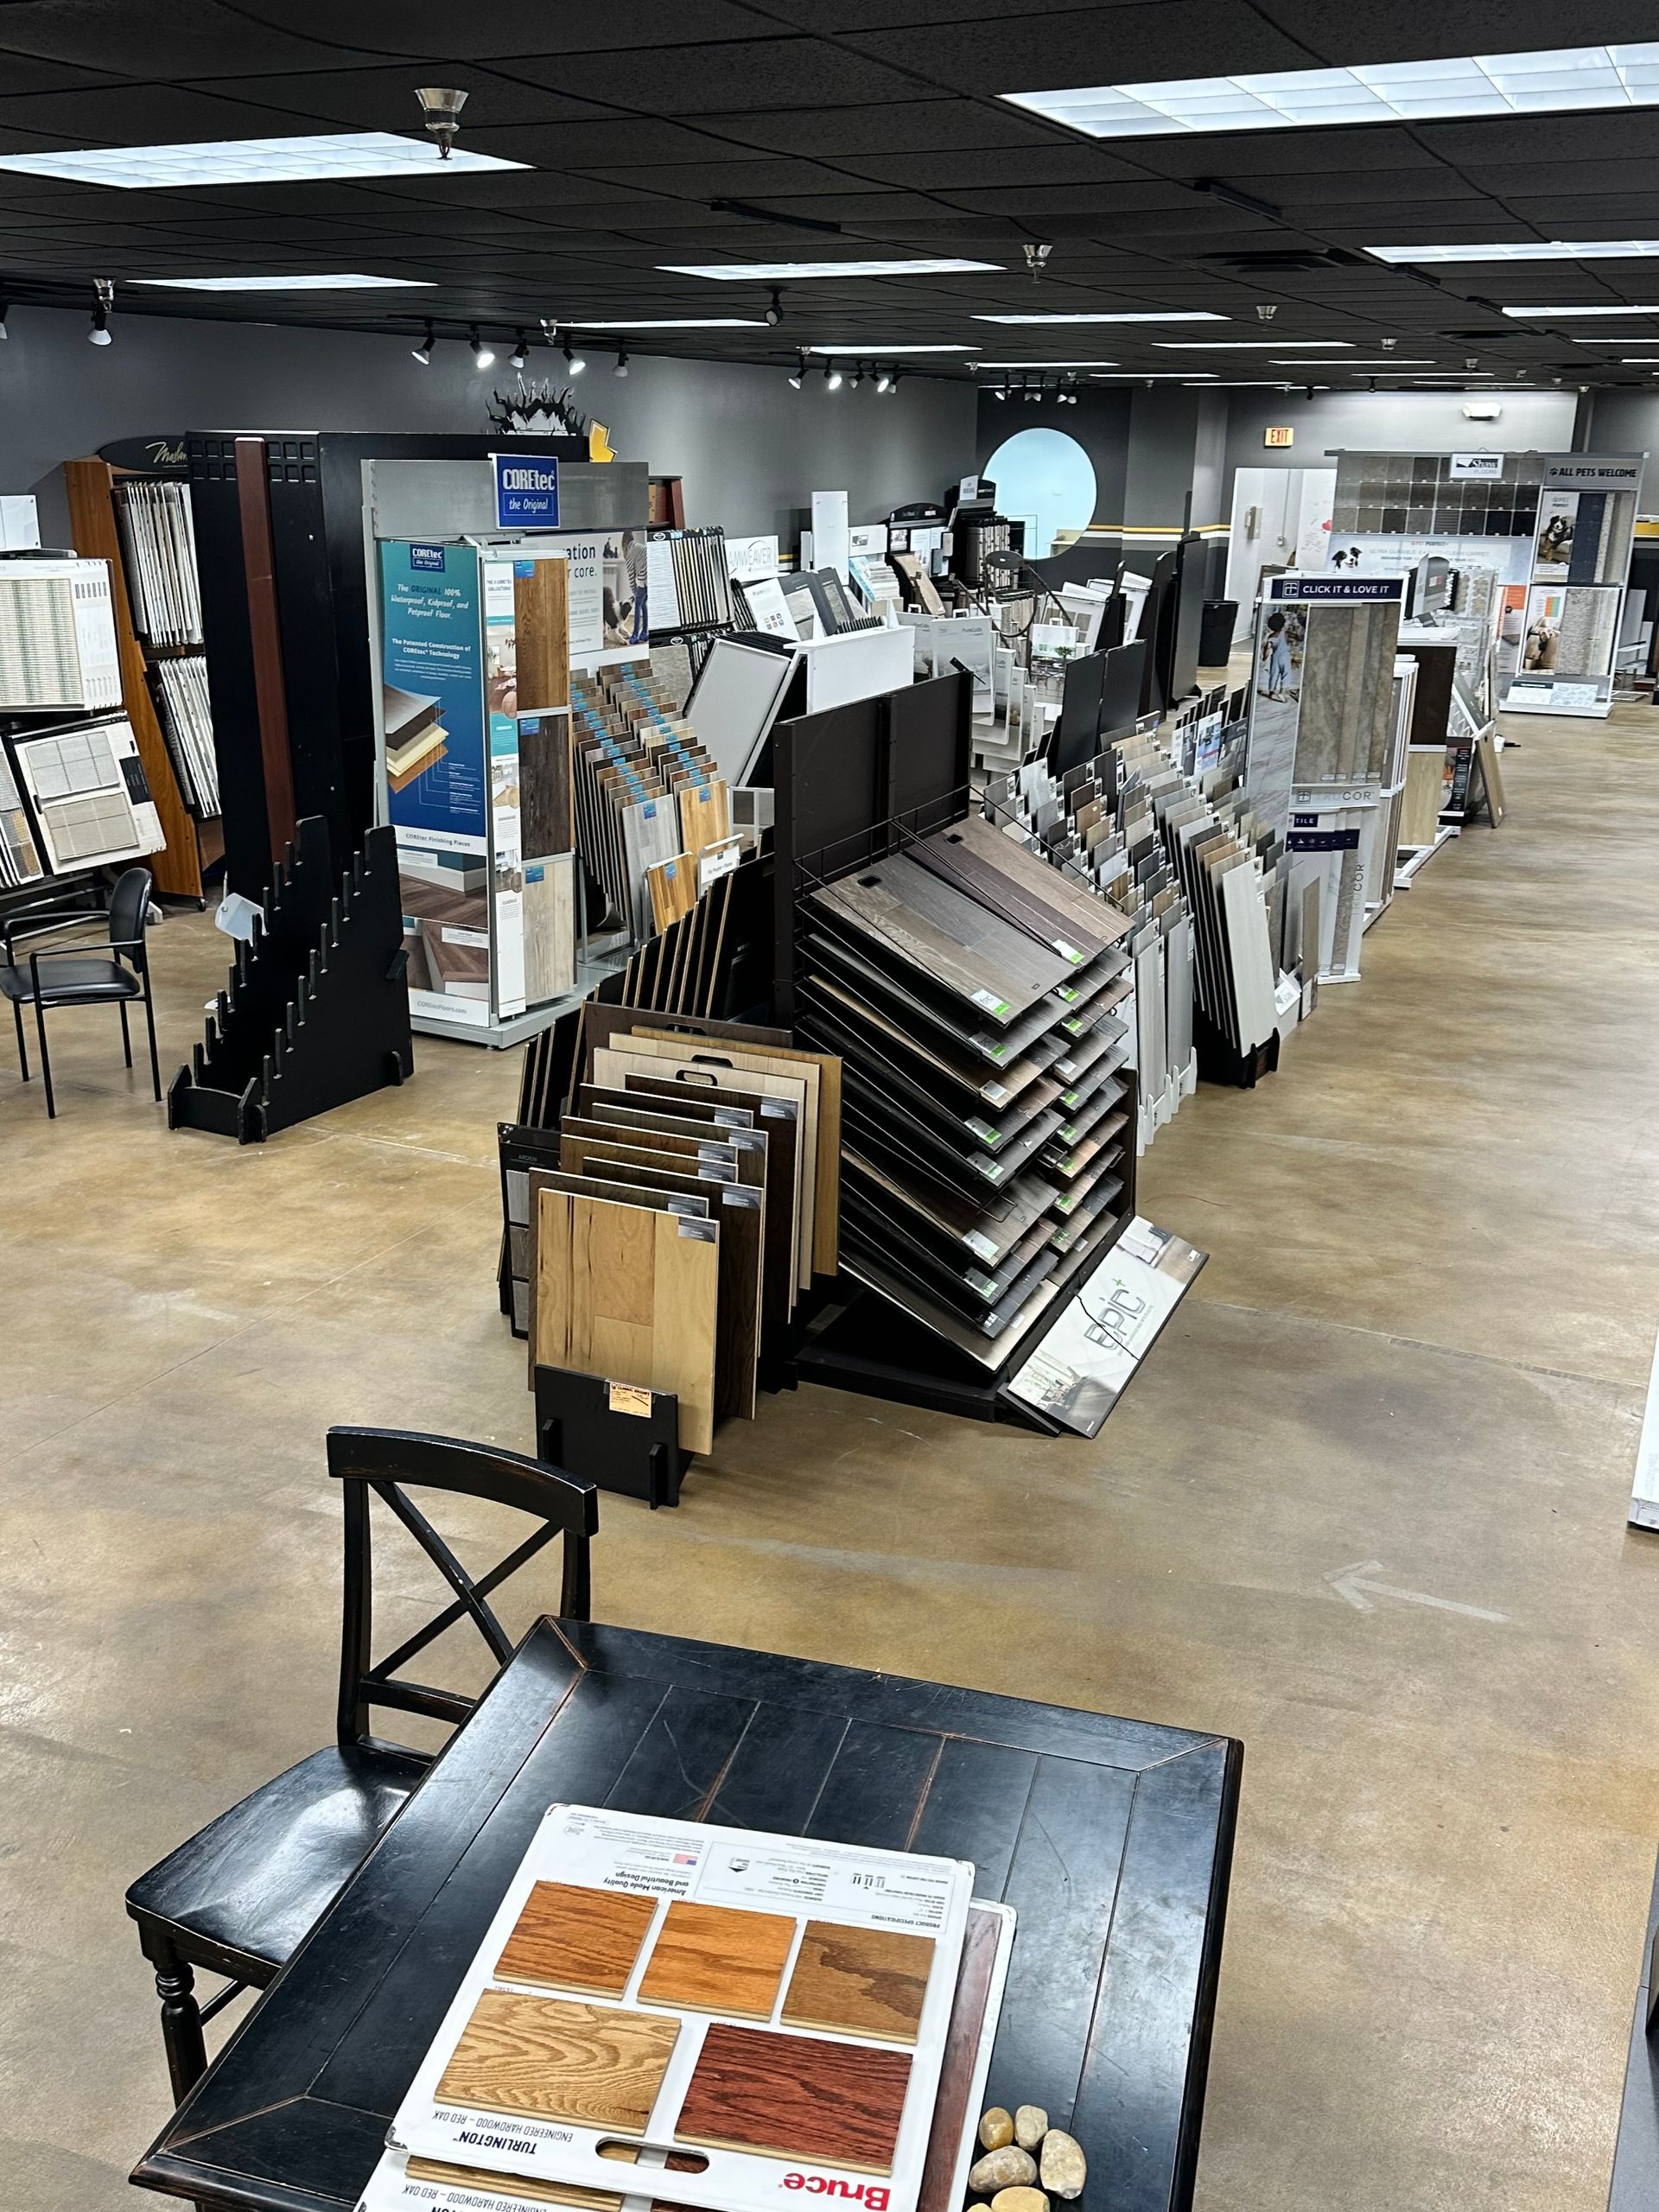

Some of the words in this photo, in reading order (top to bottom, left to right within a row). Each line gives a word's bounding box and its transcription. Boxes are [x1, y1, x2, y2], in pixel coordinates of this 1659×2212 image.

[1271, 429, 1288, 443] EXIT
[1472, 459, 1497, 468] Shaw
[1559, 467, 1573, 476] ALL
[1576, 467, 1596, 476] PETS
[1598, 468, 1637, 477] WELCOME
[509, 498, 520, 510] the
[523, 498, 548, 513] Original
[567, 543, 595, 560] ation
[575, 568, 597, 578] core.
[397, 584, 409, 593] The
[411, 585, 442, 595] ORIGINAL
[444, 588, 461, 597] 100%
[1303, 585, 1332, 594] CLICK
[1333, 585, 1342, 594] IT
[1344, 585, 1351, 594] &
[1353, 585, 1378, 594] LOVE
[1380, 585, 1389, 594] IT
[391, 595, 426, 607] Waterproof,
[428, 599, 455, 610] Kidproof,
[408, 607, 433, 618] Petproof
[435, 610, 453, 619] Floor.
[403, 639, 428, 648] Patented
[429, 642, 464, 652] Construction
[429, 650, 460, 659] Technology
[429, 836, 453, 846] Finishing
[454, 839, 471, 848] Pieces
[603, 1877, 629, 1888] Quality
[615, 1871, 639, 1882] Design
[640, 1875, 675, 1886] Beautiful
[630, 1882, 651, 1891] Made
[652, 1885, 687, 1897] American
[870, 1914, 914, 1925] SPECIFICATIONS
[915, 1920, 941, 1929] PRODUCT
[433, 2109, 448, 2121] OAK
[449, 2113, 467, 2125] RED
[476, 2117, 523, 2134] HARDWOOD
[524, 2126, 574, 2143] ENGINEERED
[402, 2183, 419, 2196] OAK
[421, 2188, 439, 2200] RED
[783, 2172, 892, 2212] Bruce
[447, 2192, 495, 2209] HARDWOOD
